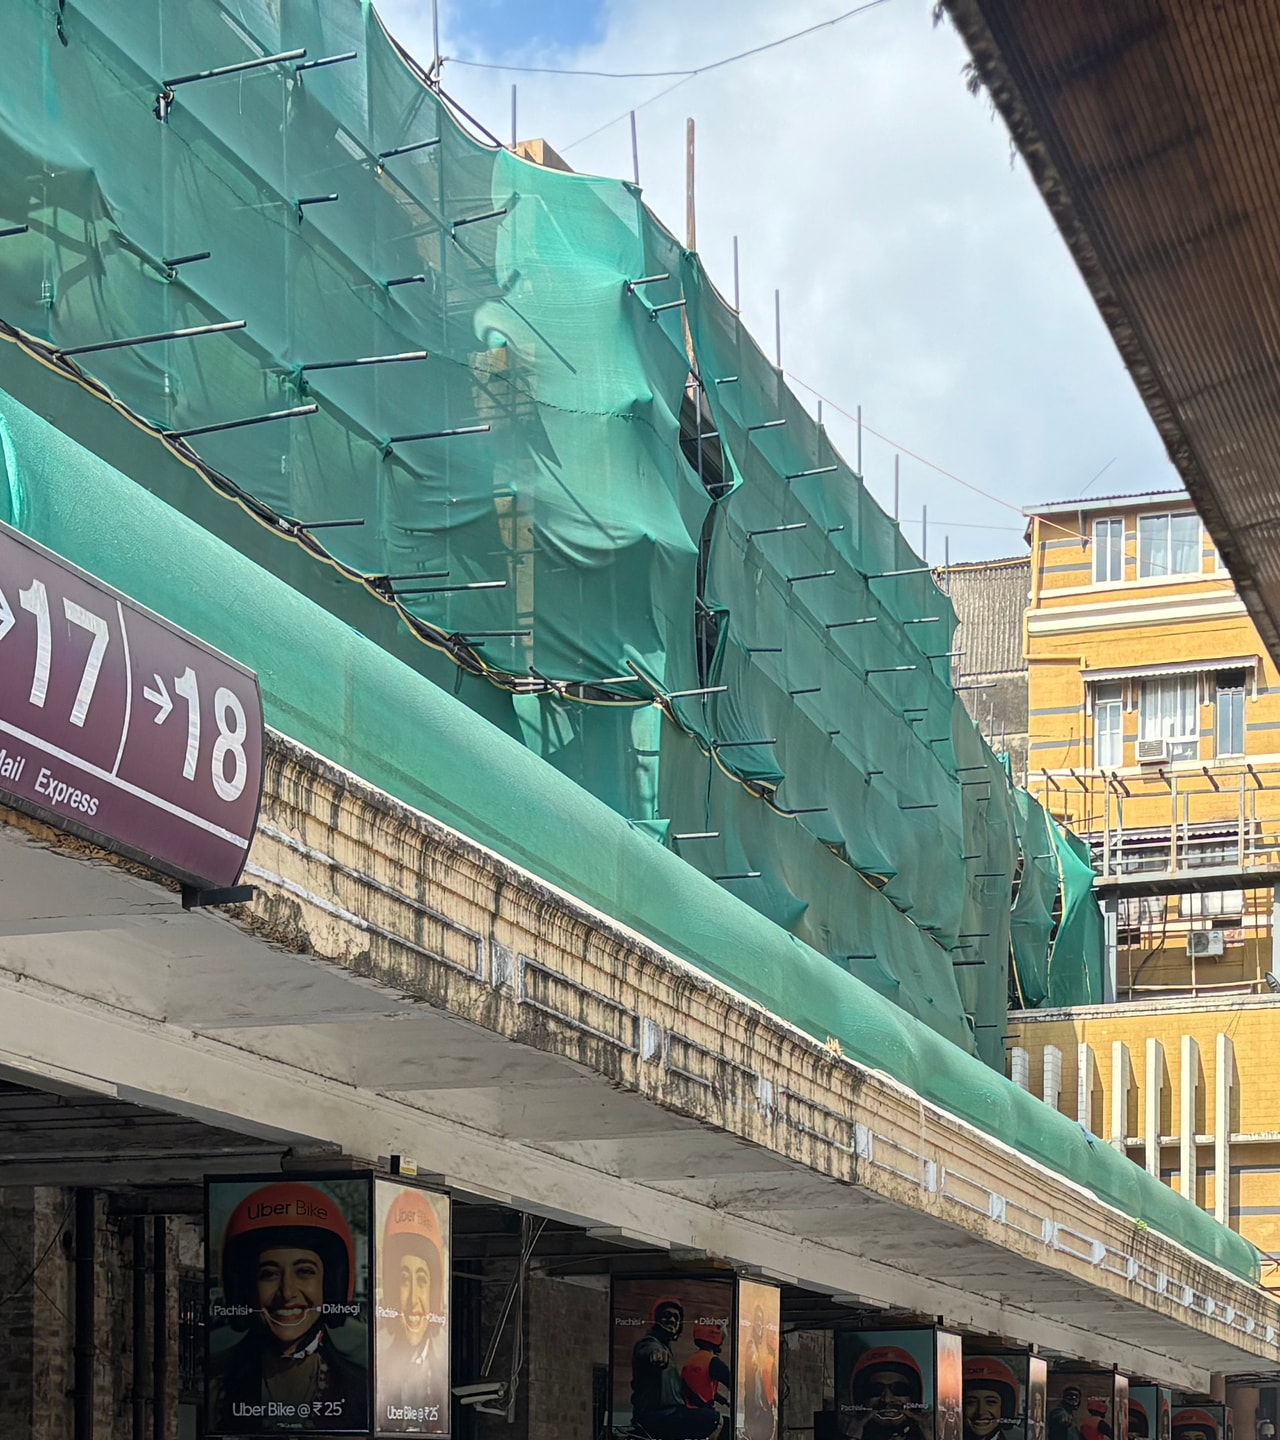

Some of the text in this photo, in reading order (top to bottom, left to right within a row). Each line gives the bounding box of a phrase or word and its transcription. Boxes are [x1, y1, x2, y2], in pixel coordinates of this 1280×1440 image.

[19, 578, 110, 729] 17
[174, 665, 248, 803] 18
[34, 765, 99, 818] Express
[248, 1199, 328, 1220] Uber Bike
[213, 1303, 361, 1317] Pachisi Dikhegi
[232, 1402, 267, 1417] Uber
[268, 1402, 296, 1417] Bike
[387, 1405, 403, 1420] Uber
